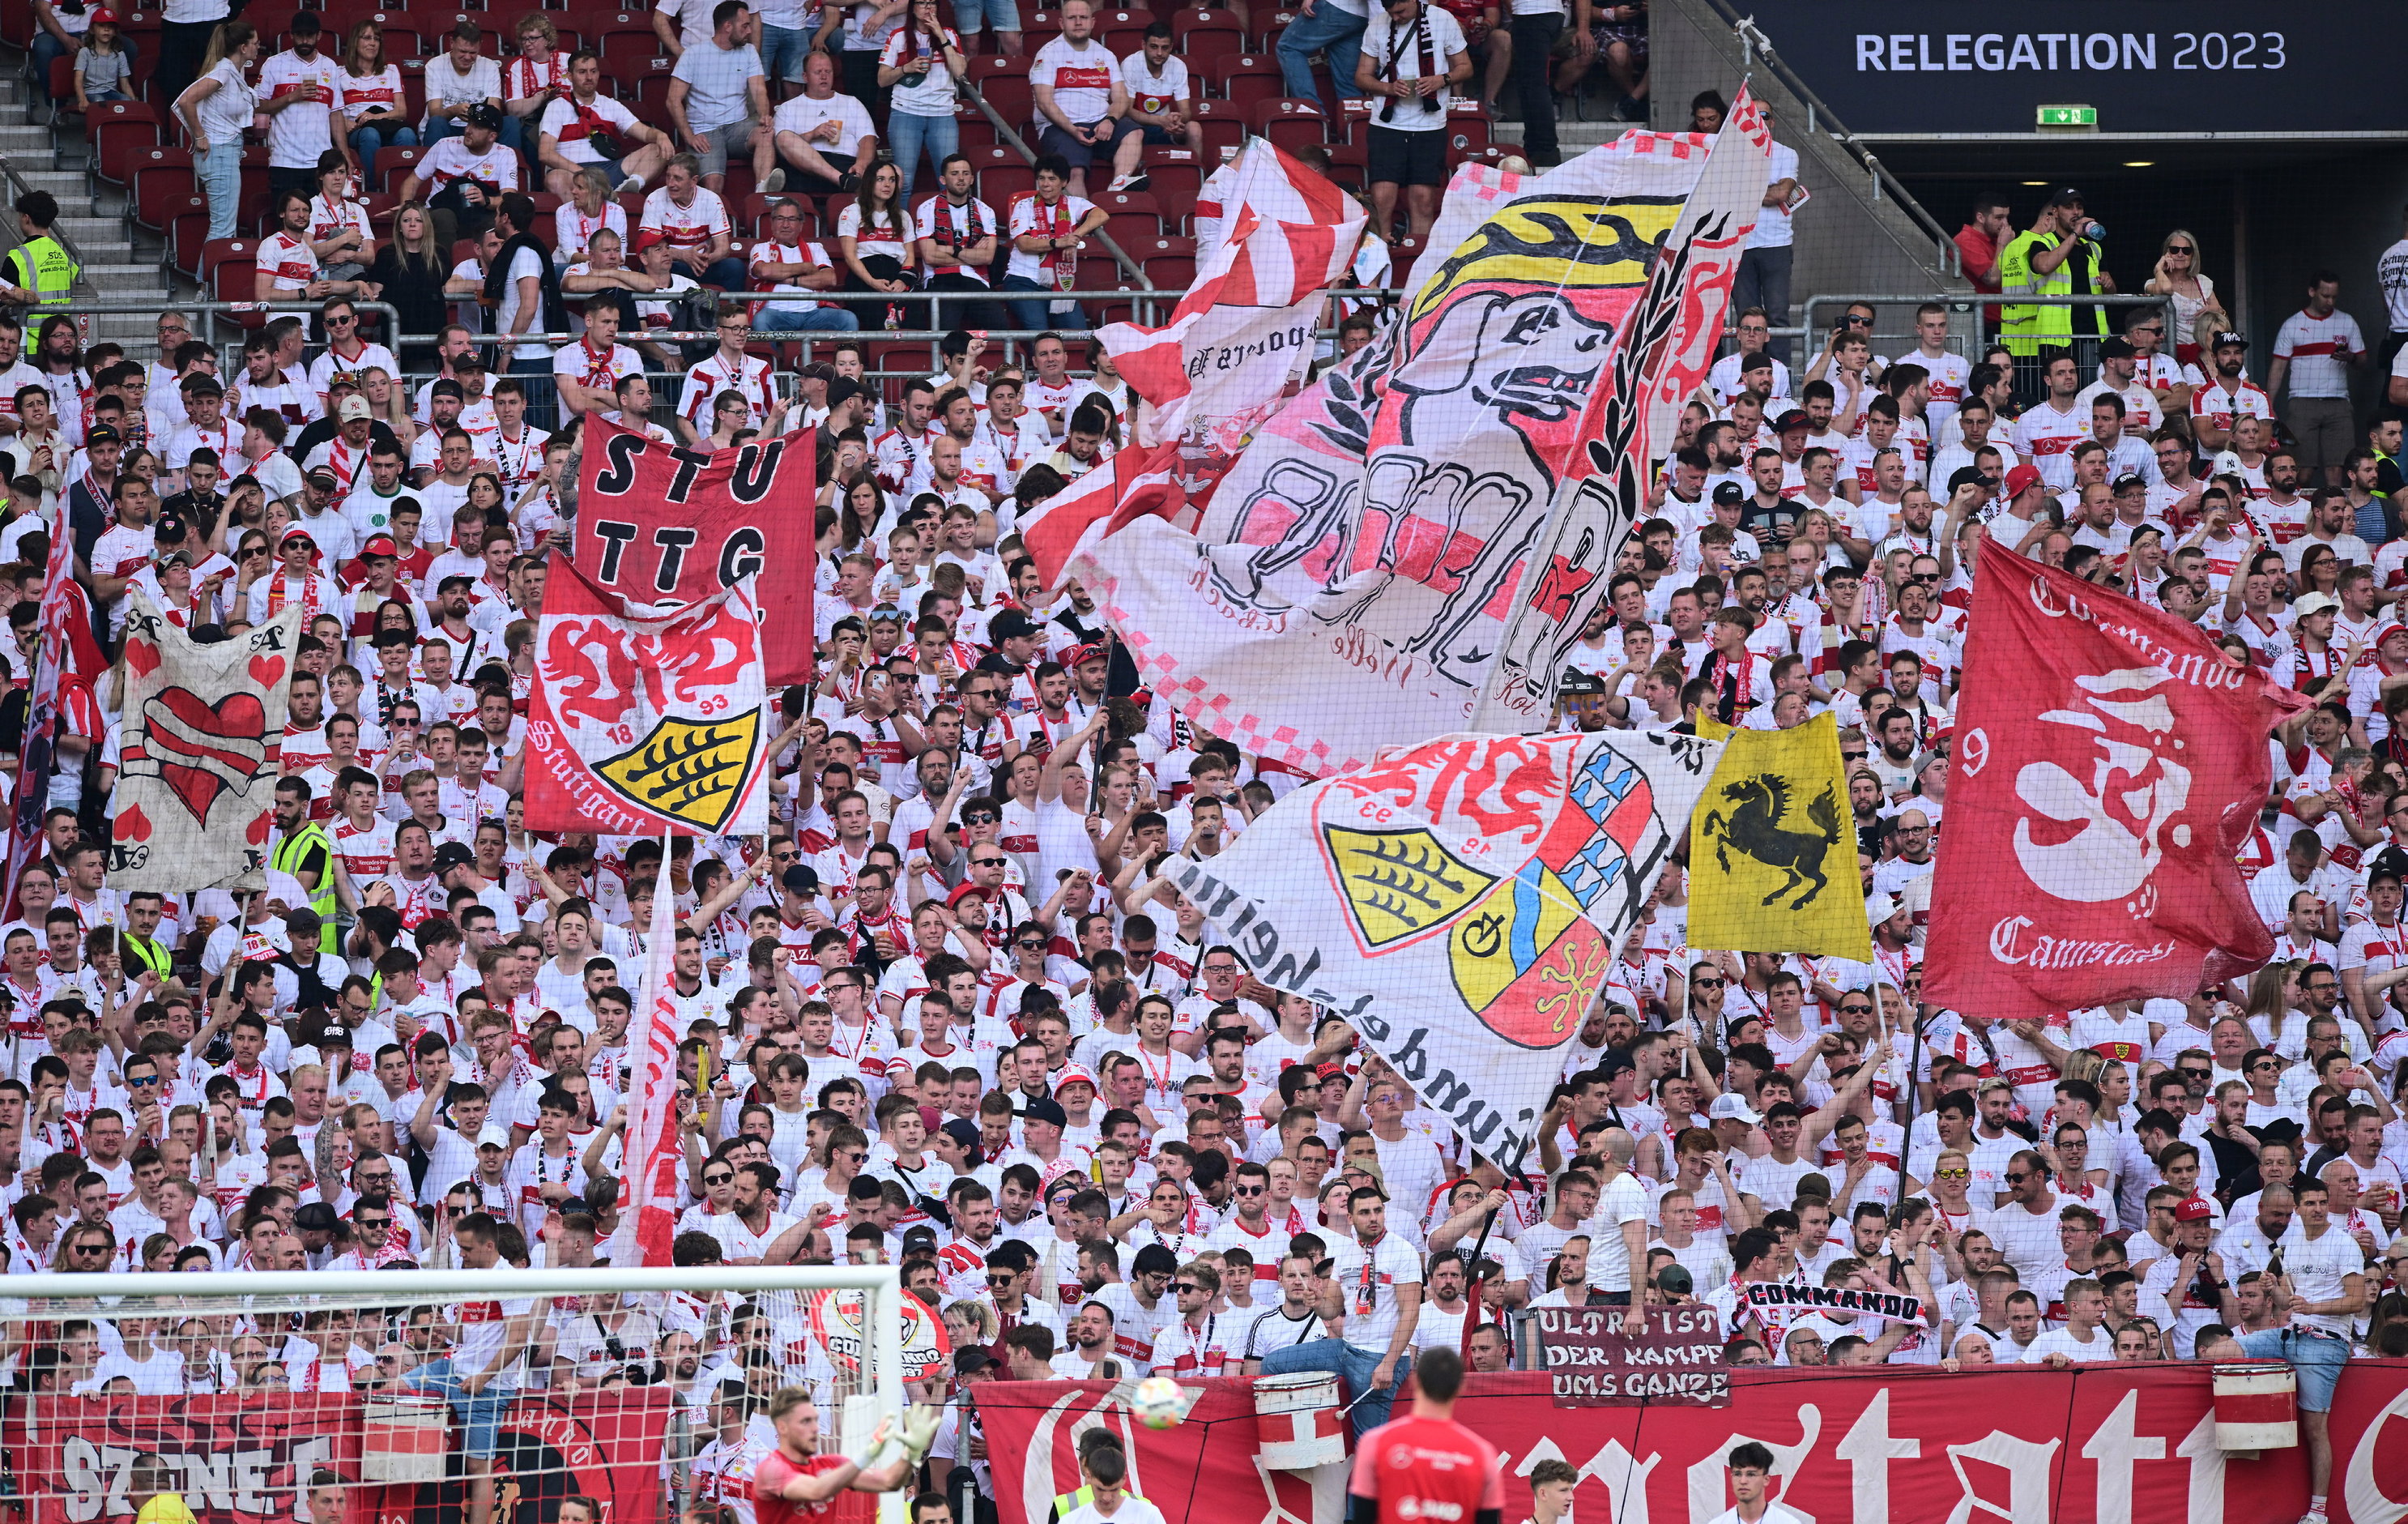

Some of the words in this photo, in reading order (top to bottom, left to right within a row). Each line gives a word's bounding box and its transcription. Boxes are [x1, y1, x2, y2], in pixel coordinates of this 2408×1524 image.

[1856, 33, 2156, 71] RELEGATION
[2174, 32, 2286, 70] 2023
[48, 251, 62, 259] SDS
[352, 402, 359, 410] NY
[2057, 438, 2079, 446] Merced
[2227, 459, 2235, 468] NY
[699, 694, 728, 715] 93
[607, 724, 633, 745] 18
[1963, 728, 1989, 777] 9
[526, 720, 646, 835] Stuttgart
[246, 941, 258, 950] 18
[252, 951, 280, 962] STUTTG
[2023, 1067, 2054, 1077] Mercedes-Be
[1748, 1283, 1920, 1321] COMMANDO
[1663, 1308, 1717, 1335] IST
[1545, 1344, 1613, 1368] DER
[1625, 1342, 1724, 1367] KAMPF
[1553, 1372, 1618, 1398] UMS
[1625, 1372, 1728, 1402] GANZE
[62, 1434, 277, 1524] SZNE
